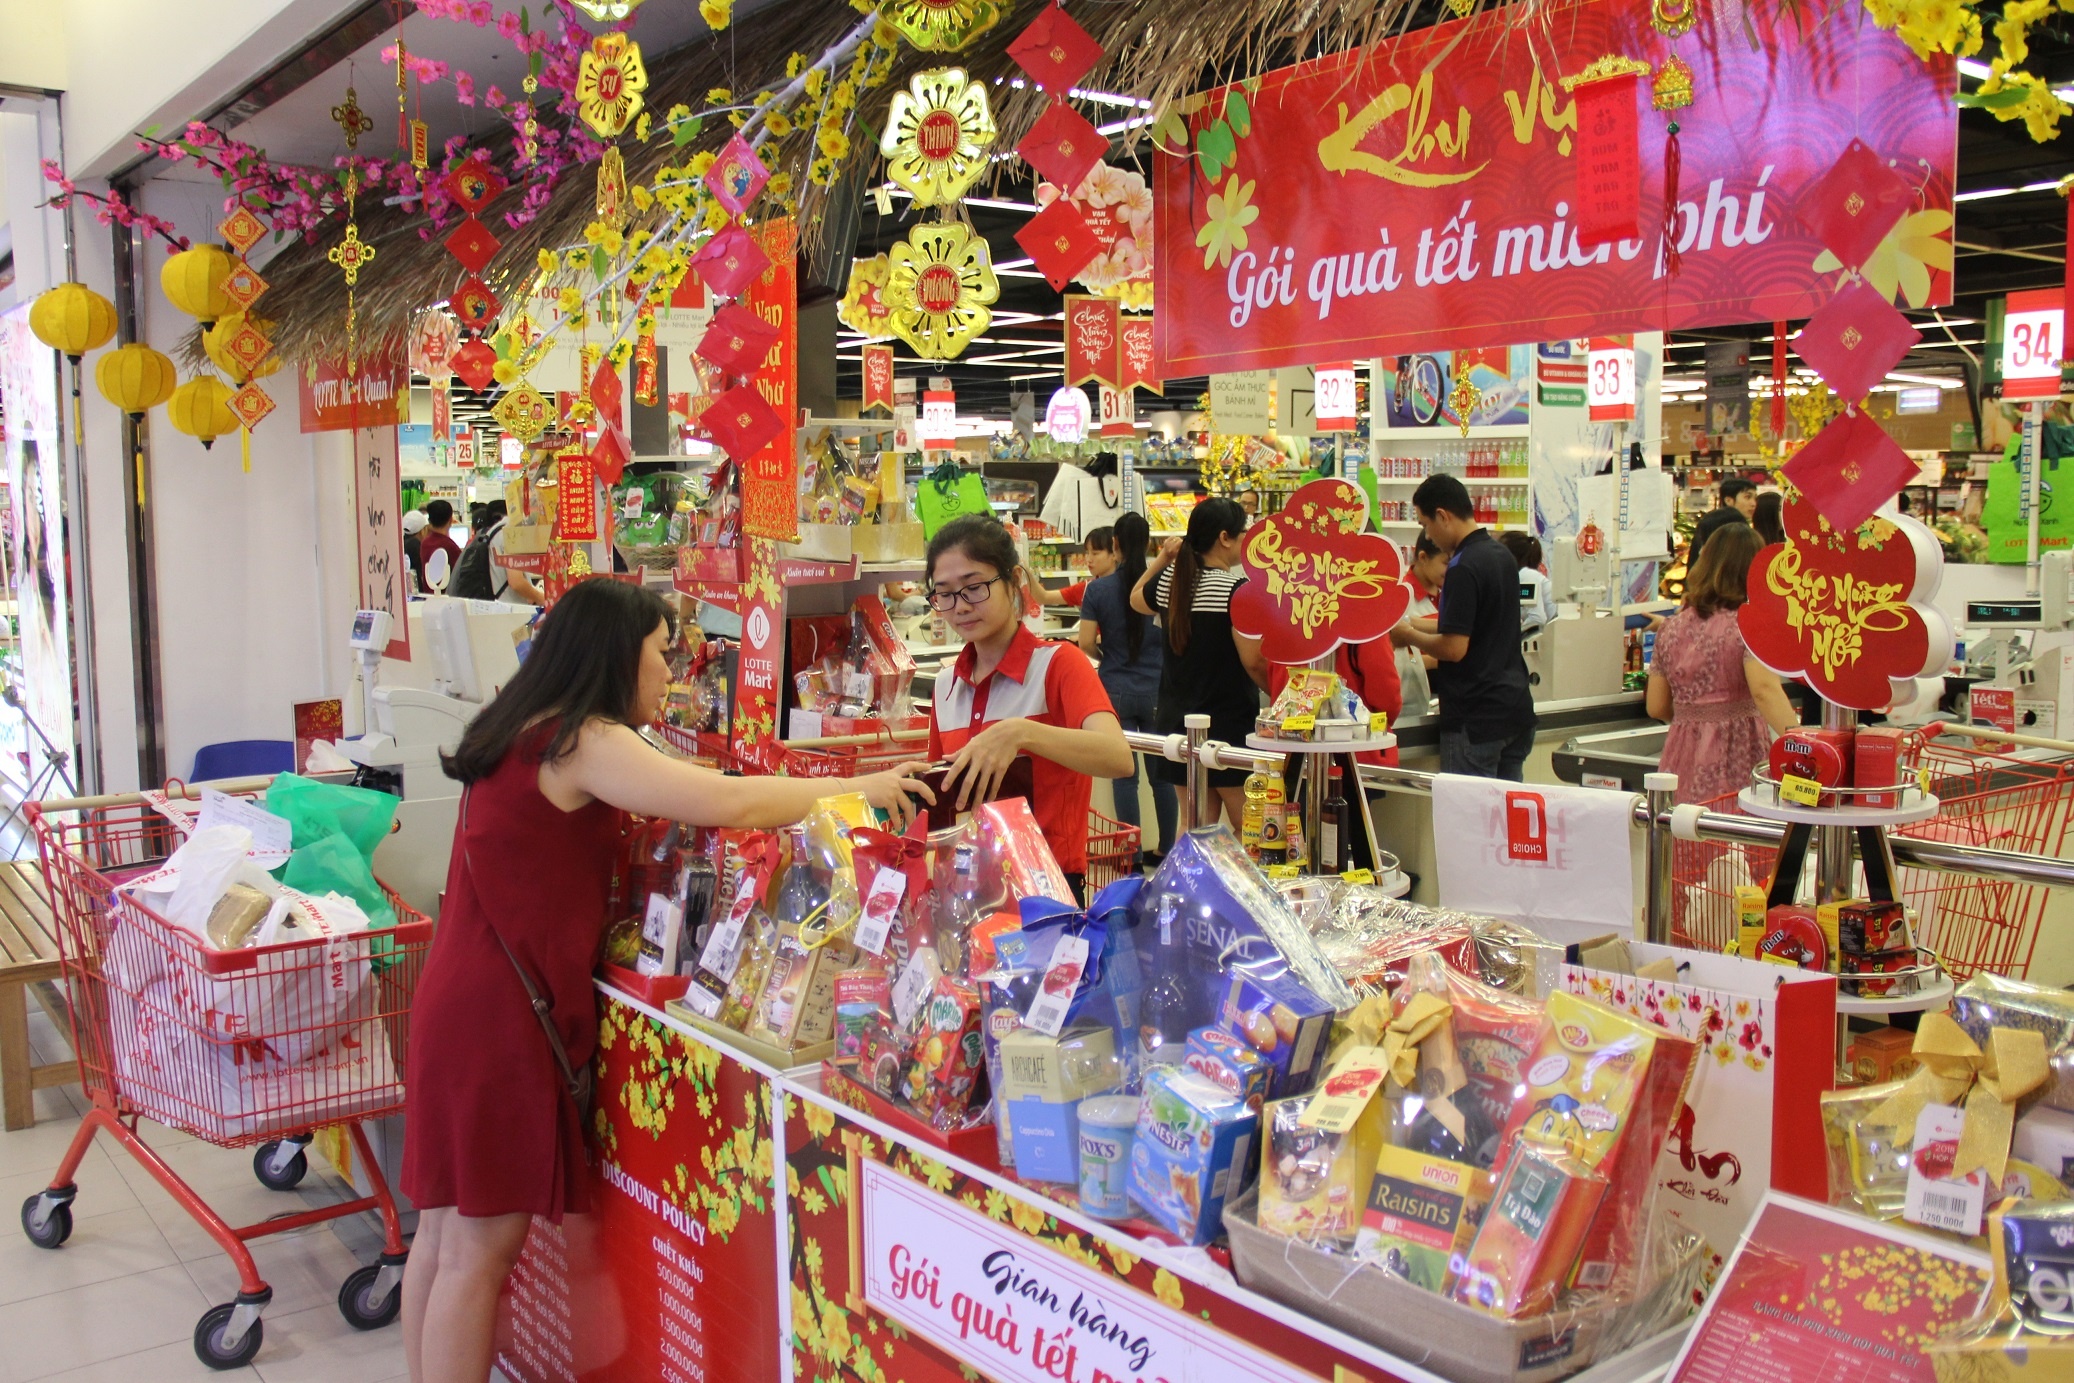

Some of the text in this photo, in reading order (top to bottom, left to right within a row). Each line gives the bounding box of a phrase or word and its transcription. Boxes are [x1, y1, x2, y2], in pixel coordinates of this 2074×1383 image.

[1318, 71, 1491, 188] Khu
[1227, 165, 1776, 328] Gói quà tết phí
[2013, 323, 2052, 368] 34
[341, 378, 361, 406] Mrt
[1321, 378, 1339, 408] 32
[1595, 359, 1620, 396] 33
[1104, 386, 1120, 419] 31
[927, 408, 939, 431] 30
[459, 444, 471, 459] 25
[2040, 537, 2068, 546] Mart
[786, 567, 802, 578] Xuân
[703, 589, 716, 599] Xuân
[745, 658, 772, 672] LOTTE
[745, 671, 772, 690] Mart
[1602, 780, 1617, 788] Mart
[1742, 902, 1763, 910] Raisins
[1819, 910, 1838, 921] Raisins
[1011, 1054, 1048, 1084] ARCHCAFÉ
[1151, 1121, 1190, 1158] NESTEA
[602, 1159, 706, 1246] DISCOUNT POLICY
[1375, 1183, 1450, 1226] Raisins
[652, 1236, 704, 1283] CHIẾT KHẤU
[656, 1262, 694, 1301] 500.000đ
[658, 1287, 702, 1332] 1.000.000đ
[889, 1244, 1079, 1383] Gói quà tết
[982, 1249, 1156, 1371] Gian hàng
[660, 1312, 703, 1359] 1.500.000đ
